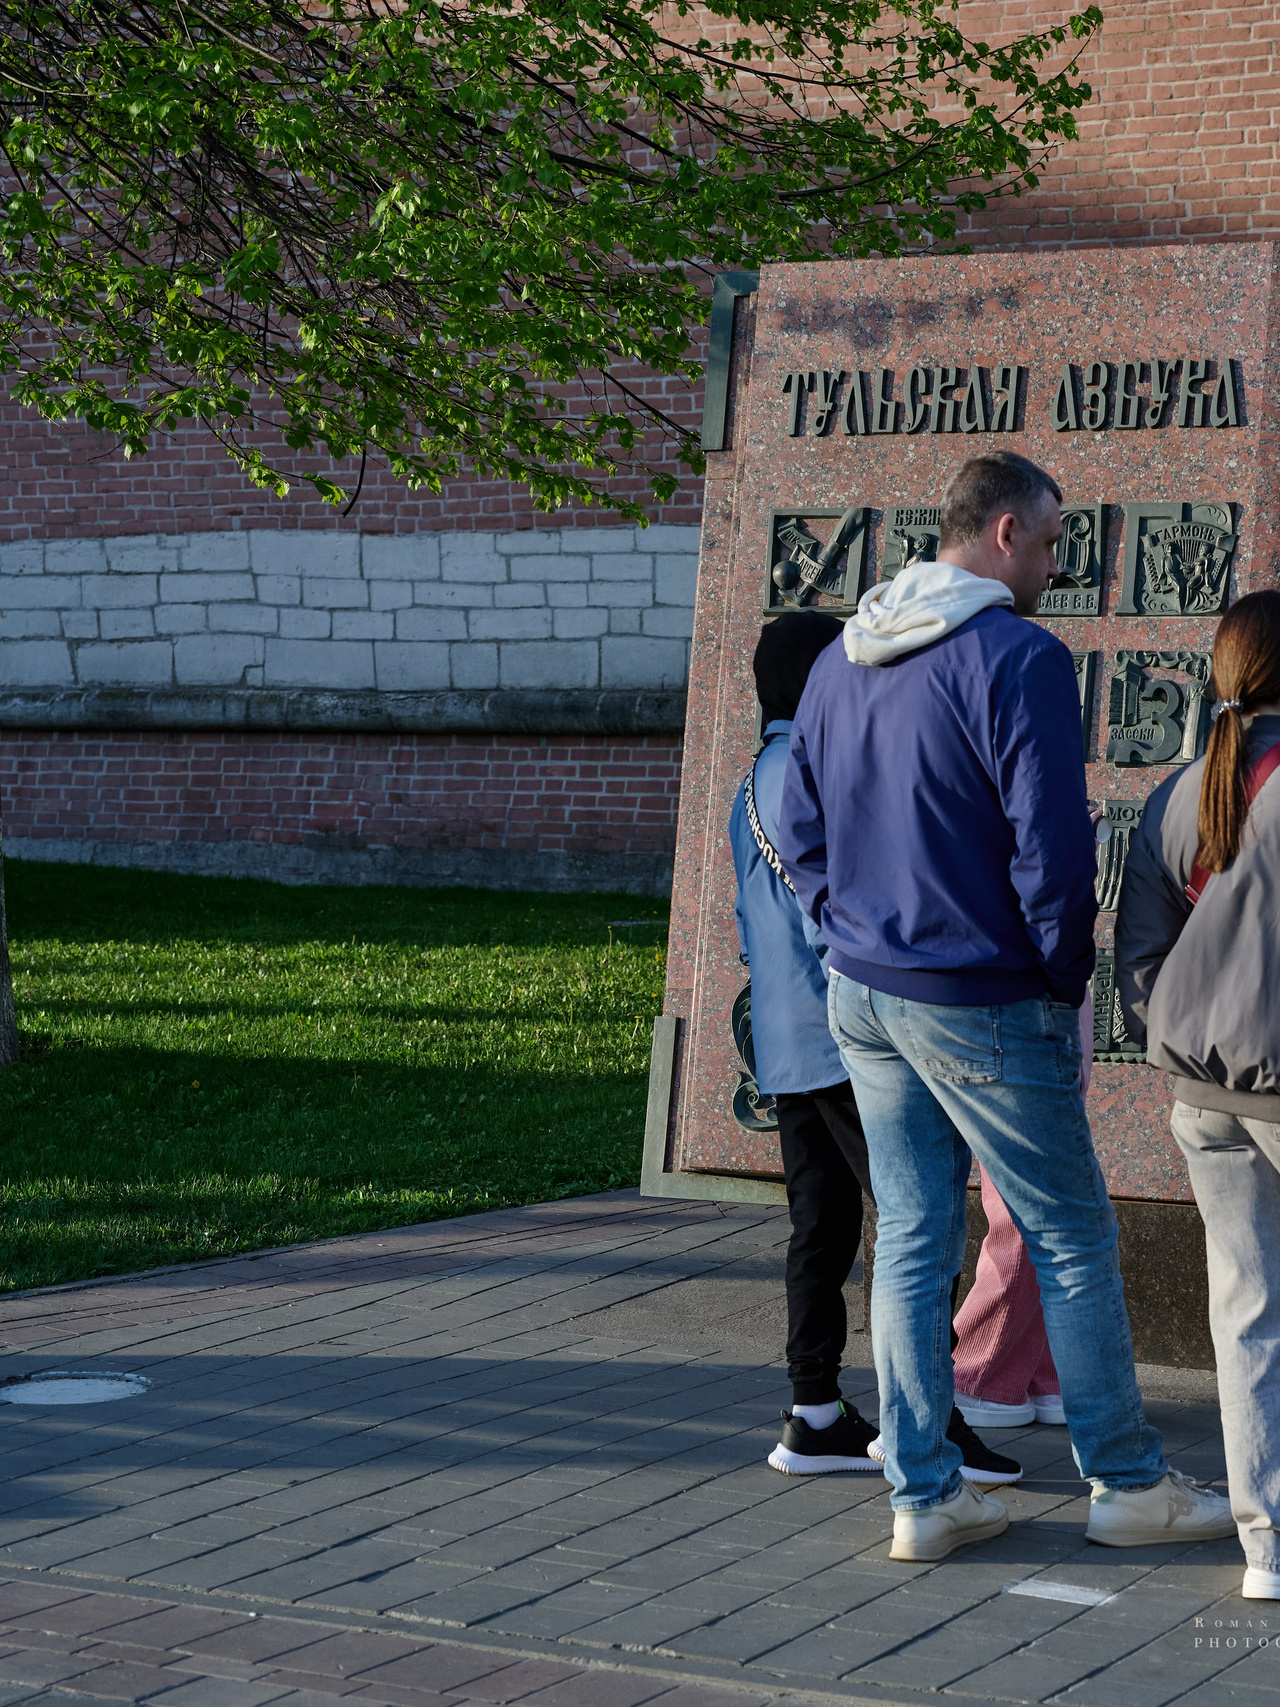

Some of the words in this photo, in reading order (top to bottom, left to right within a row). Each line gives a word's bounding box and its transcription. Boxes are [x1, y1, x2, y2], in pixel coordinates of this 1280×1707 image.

[781, 364, 1023, 438] ТУЛЬСКАЯ
[1051, 358, 1241, 433] АЗБУКА
[1155, 524, 1216, 545] ГАРМОНЬ
[1038, 594, 1069, 609] САЕВ
[1107, 806, 1144, 822] МОС
[1095, 962, 1114, 1044] ПРЯНИК
